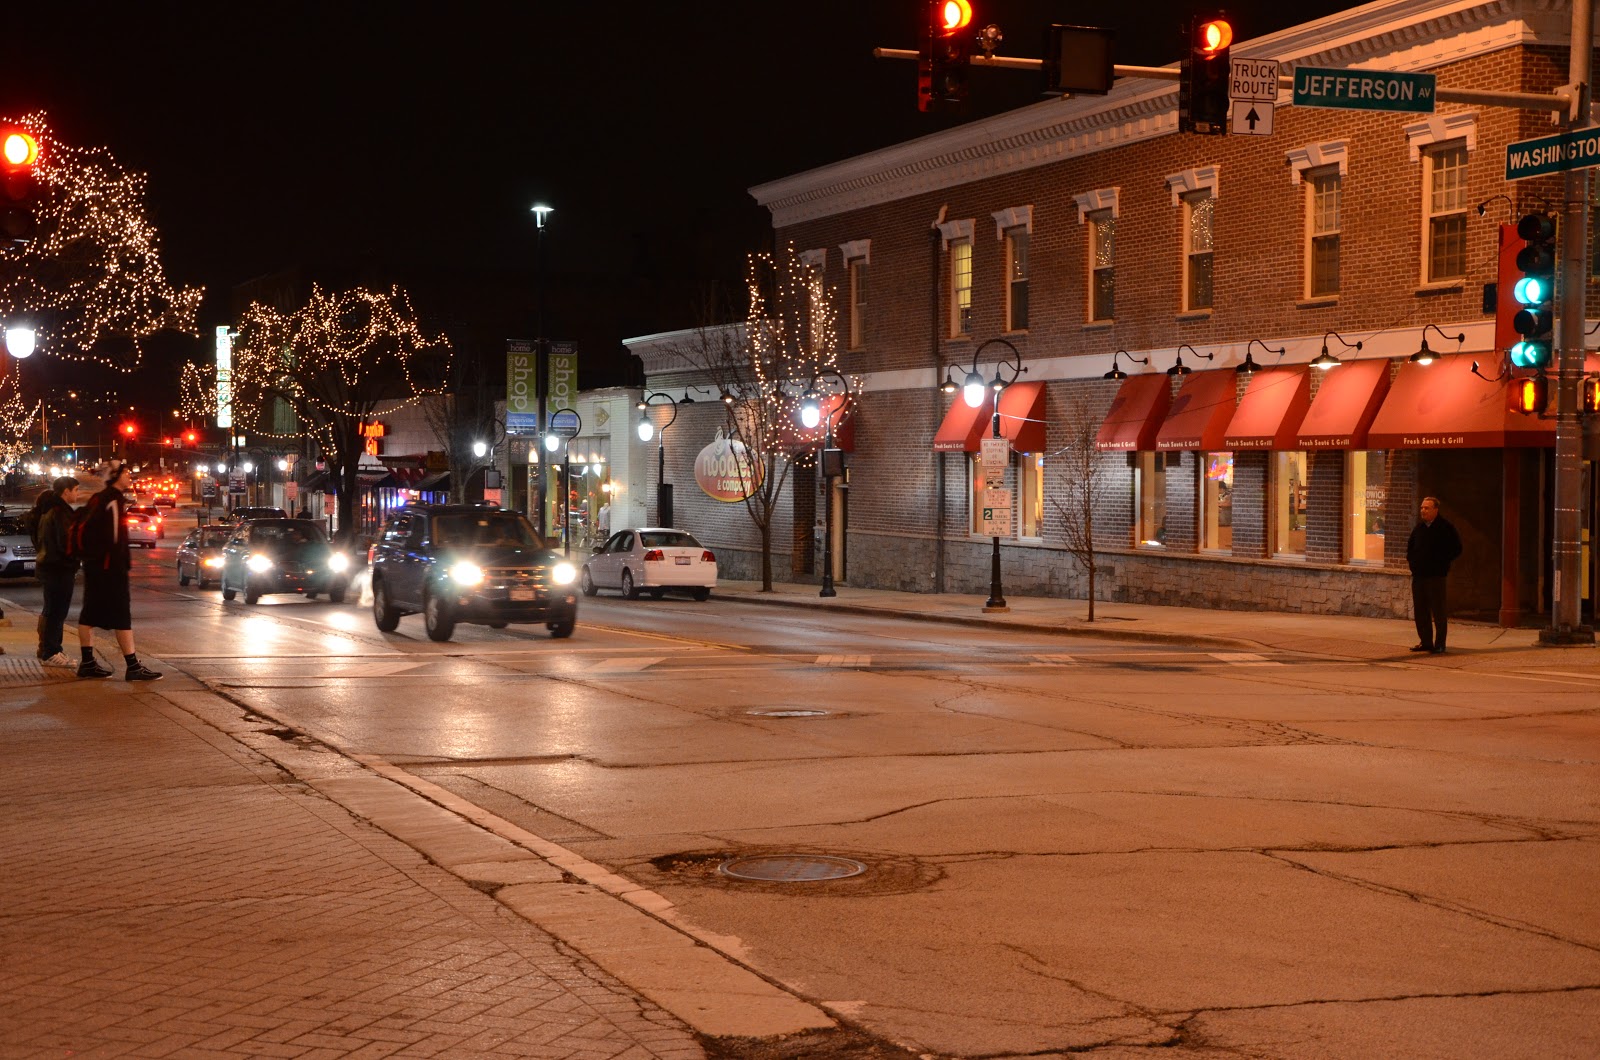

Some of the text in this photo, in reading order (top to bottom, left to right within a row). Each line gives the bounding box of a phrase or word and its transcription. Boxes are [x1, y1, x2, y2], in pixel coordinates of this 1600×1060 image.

[1234, 63, 1276, 79] TRUCK
[1233, 80, 1275, 95] ROUTE
[1298, 75, 1432, 101] JEFFERSON AV
[1509, 136, 1600, 170] WASHINGTO
[510, 344, 531, 352] home
[551, 345, 573, 353] home
[510, 356, 533, 410] shop
[551, 358, 575, 410] shop
[1403, 437, 1420, 445] Fresh
[717, 479, 752, 497] & company
[984, 510, 991, 519] 2
